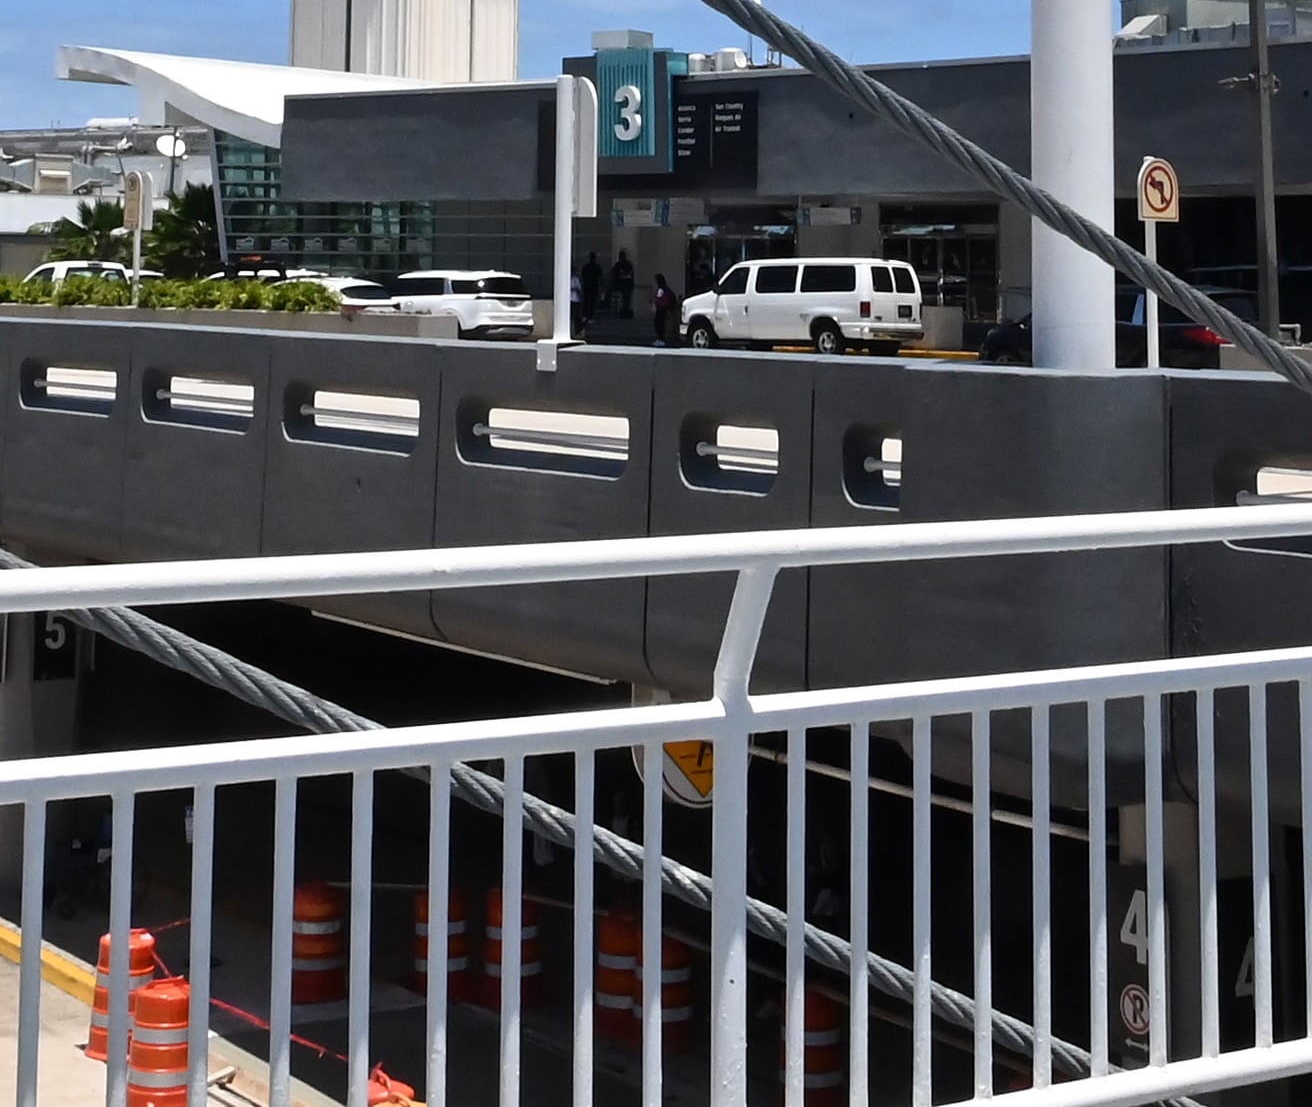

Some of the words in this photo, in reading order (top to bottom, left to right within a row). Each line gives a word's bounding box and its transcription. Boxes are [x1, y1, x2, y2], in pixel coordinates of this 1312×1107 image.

[614, 85, 642, 141] 3
[44, 611, 66, 649] 5
[1120, 889, 1149, 965] 4
